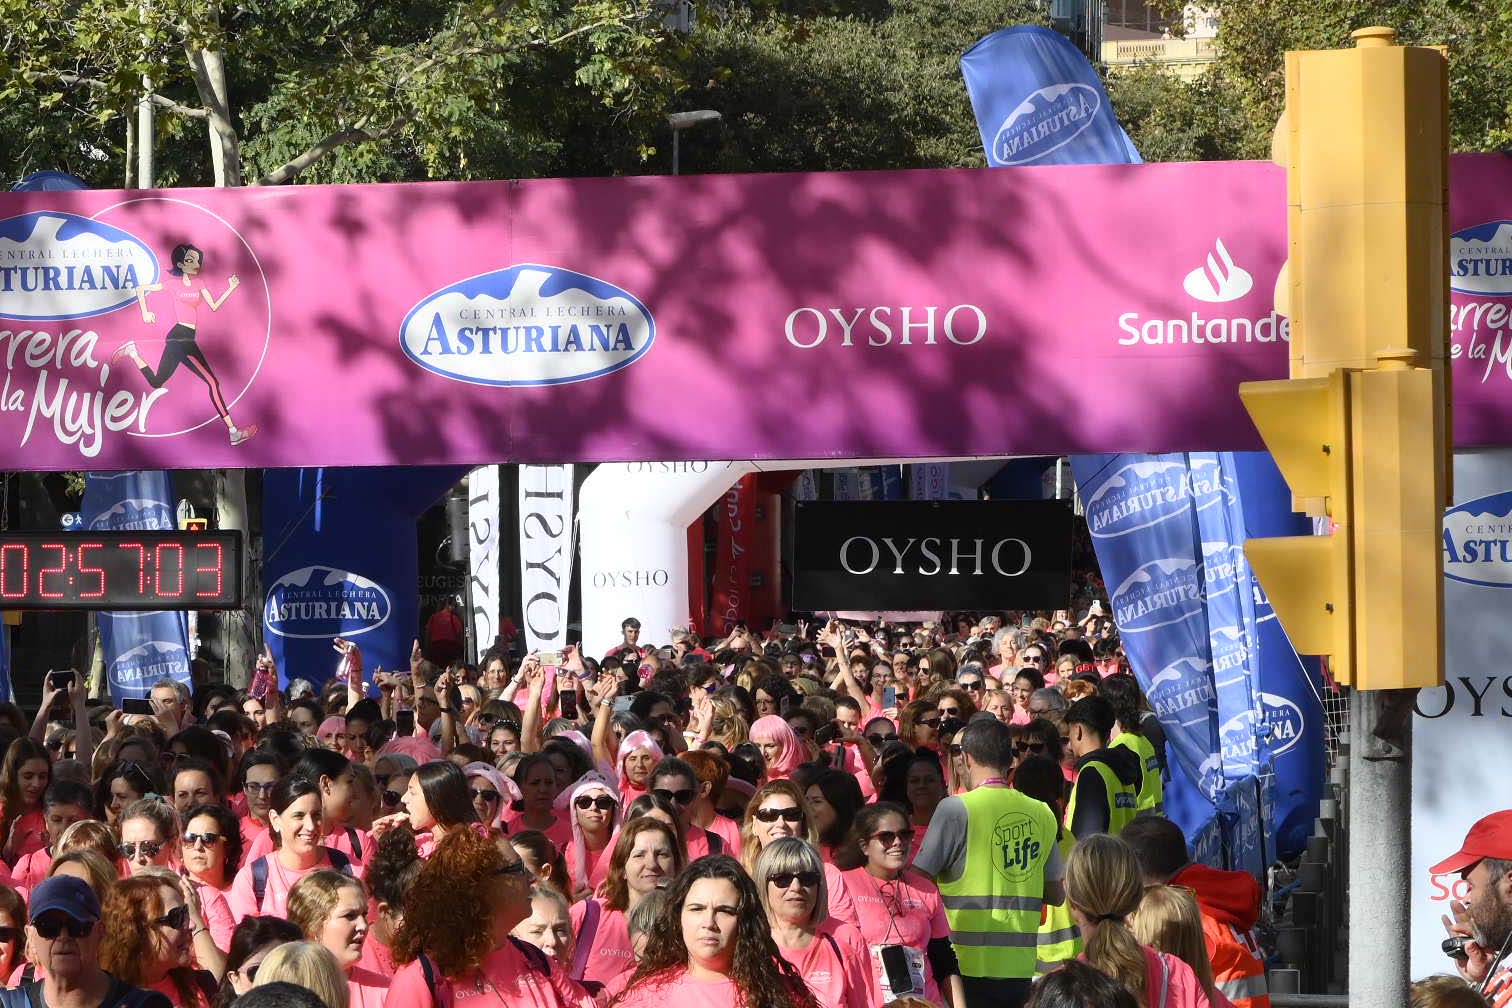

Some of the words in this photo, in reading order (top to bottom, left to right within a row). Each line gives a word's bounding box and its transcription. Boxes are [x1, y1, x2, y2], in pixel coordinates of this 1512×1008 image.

[61, 247, 135, 259] LECHERA
[459, 307, 537, 320] CENTRAL
[546, 304, 628, 317] LECHERA
[785, 303, 988, 349] OYSHO
[1118, 311, 1290, 345] Santande
[419, 312, 635, 357] ASTURIANA
[0, 371, 25, 413] la
[19, 363, 169, 458] Mujer
[0, 543, 224, 598] 02:57:03
[839, 536, 1032, 577] OYSHO
[280, 590, 324, 600] CENTRAL
[328, 589, 378, 599] LECHERA
[592, 569, 669, 589] OYSHO
[267, 598, 382, 623] ASTURIANA
[993, 817, 1033, 848] Sport
[1001, 837, 1040, 871] Life
[599, 948, 632, 959] OYSHO
